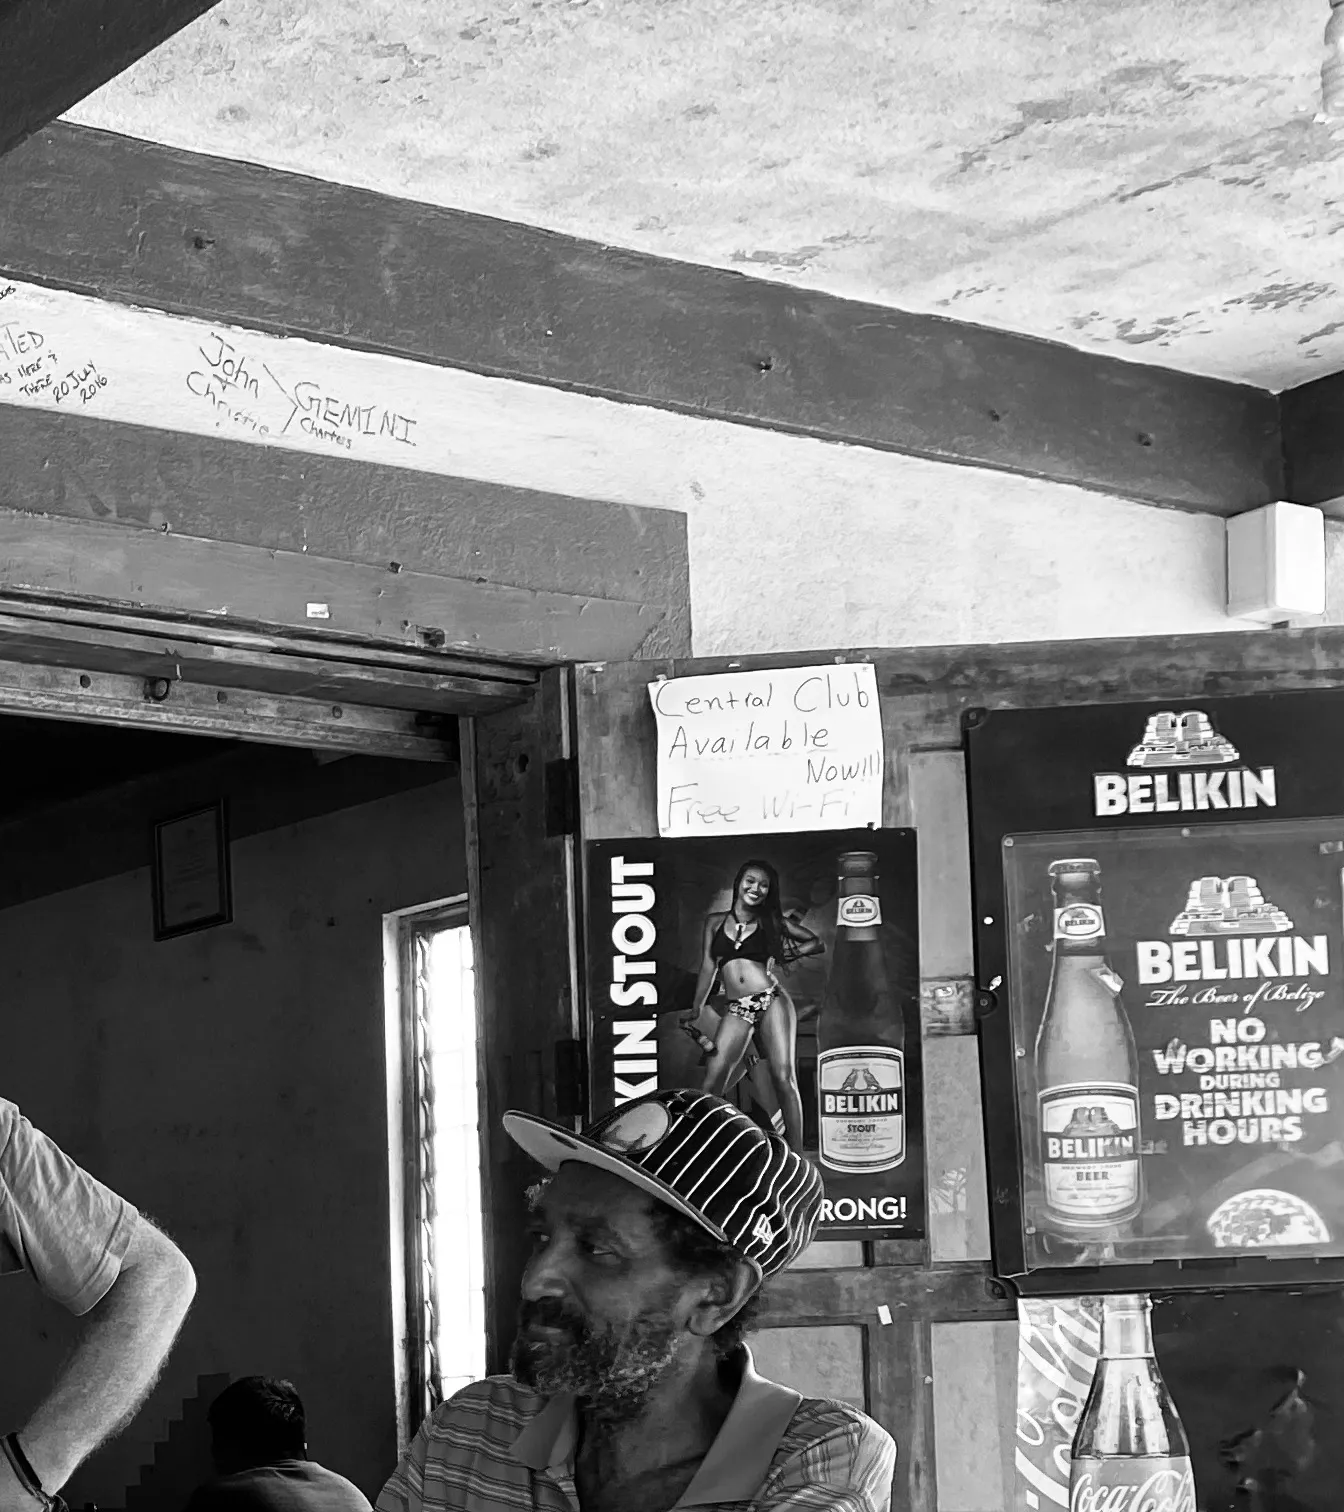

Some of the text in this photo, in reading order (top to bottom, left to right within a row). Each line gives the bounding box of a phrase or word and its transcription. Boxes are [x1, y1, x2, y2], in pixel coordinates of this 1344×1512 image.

[17, 357, 43, 378] HERE
[199, 331, 259, 399] John
[18, 373, 53, 397] THERE
[52, 360, 97, 405] 20 JULY
[79, 375, 108, 405] 2016
[655, 671, 870, 717] Central Club
[668, 719, 830, 759] Available
[667, 782, 857, 829] Free Wi-Fi
[1093, 765, 1277, 817] BELIKIN
[609, 854, 659, 1007] STOUT
[1136, 935, 1330, 985] BELIKIN
[1145, 980, 1327, 1015] The Beer of Belize
[1210, 1016, 1267, 1045] NO
[1152, 1041, 1324, 1076] WORKING
[1200, 1072, 1281, 1091] DURING
[824, 1093, 899, 1113] BELIKIN
[1154, 1087, 1329, 1120] DRINKING
[847, 1124, 877, 1133] STOUT
[1183, 1115, 1303, 1146] HOURS
[1075, 1171, 1110, 1182] BEER
[818, 1196, 908, 1222] RONG!
